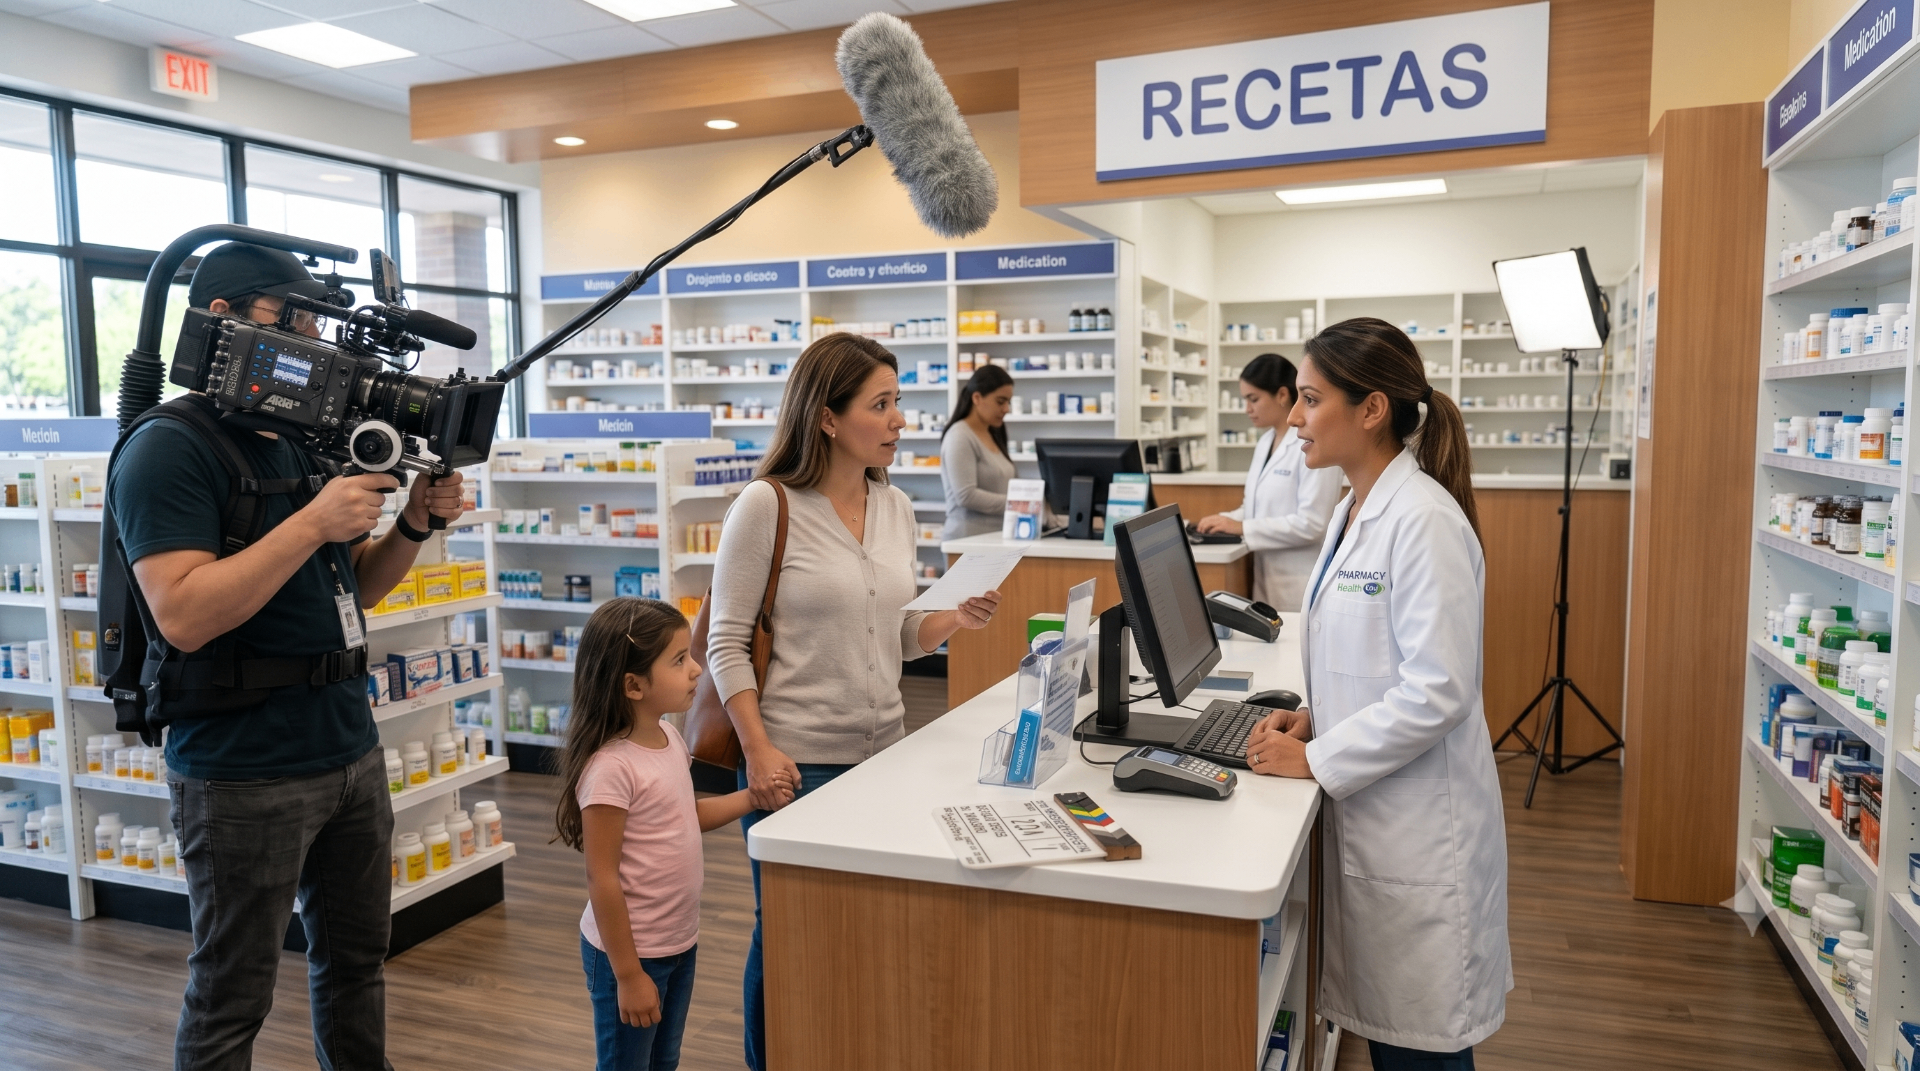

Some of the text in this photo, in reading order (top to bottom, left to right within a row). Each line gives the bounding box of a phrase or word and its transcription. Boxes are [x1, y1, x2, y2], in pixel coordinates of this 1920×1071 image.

[1844, 6, 1896, 72] Medication
[165, 53, 210, 96] EXIT
[1142, 43, 1489, 141] RECETAS
[997, 254, 1067, 270] Medication
[868, 266, 876, 280] y
[1337, 570, 1387, 581] PHARMACY
[1337, 582, 1362, 593] Health
